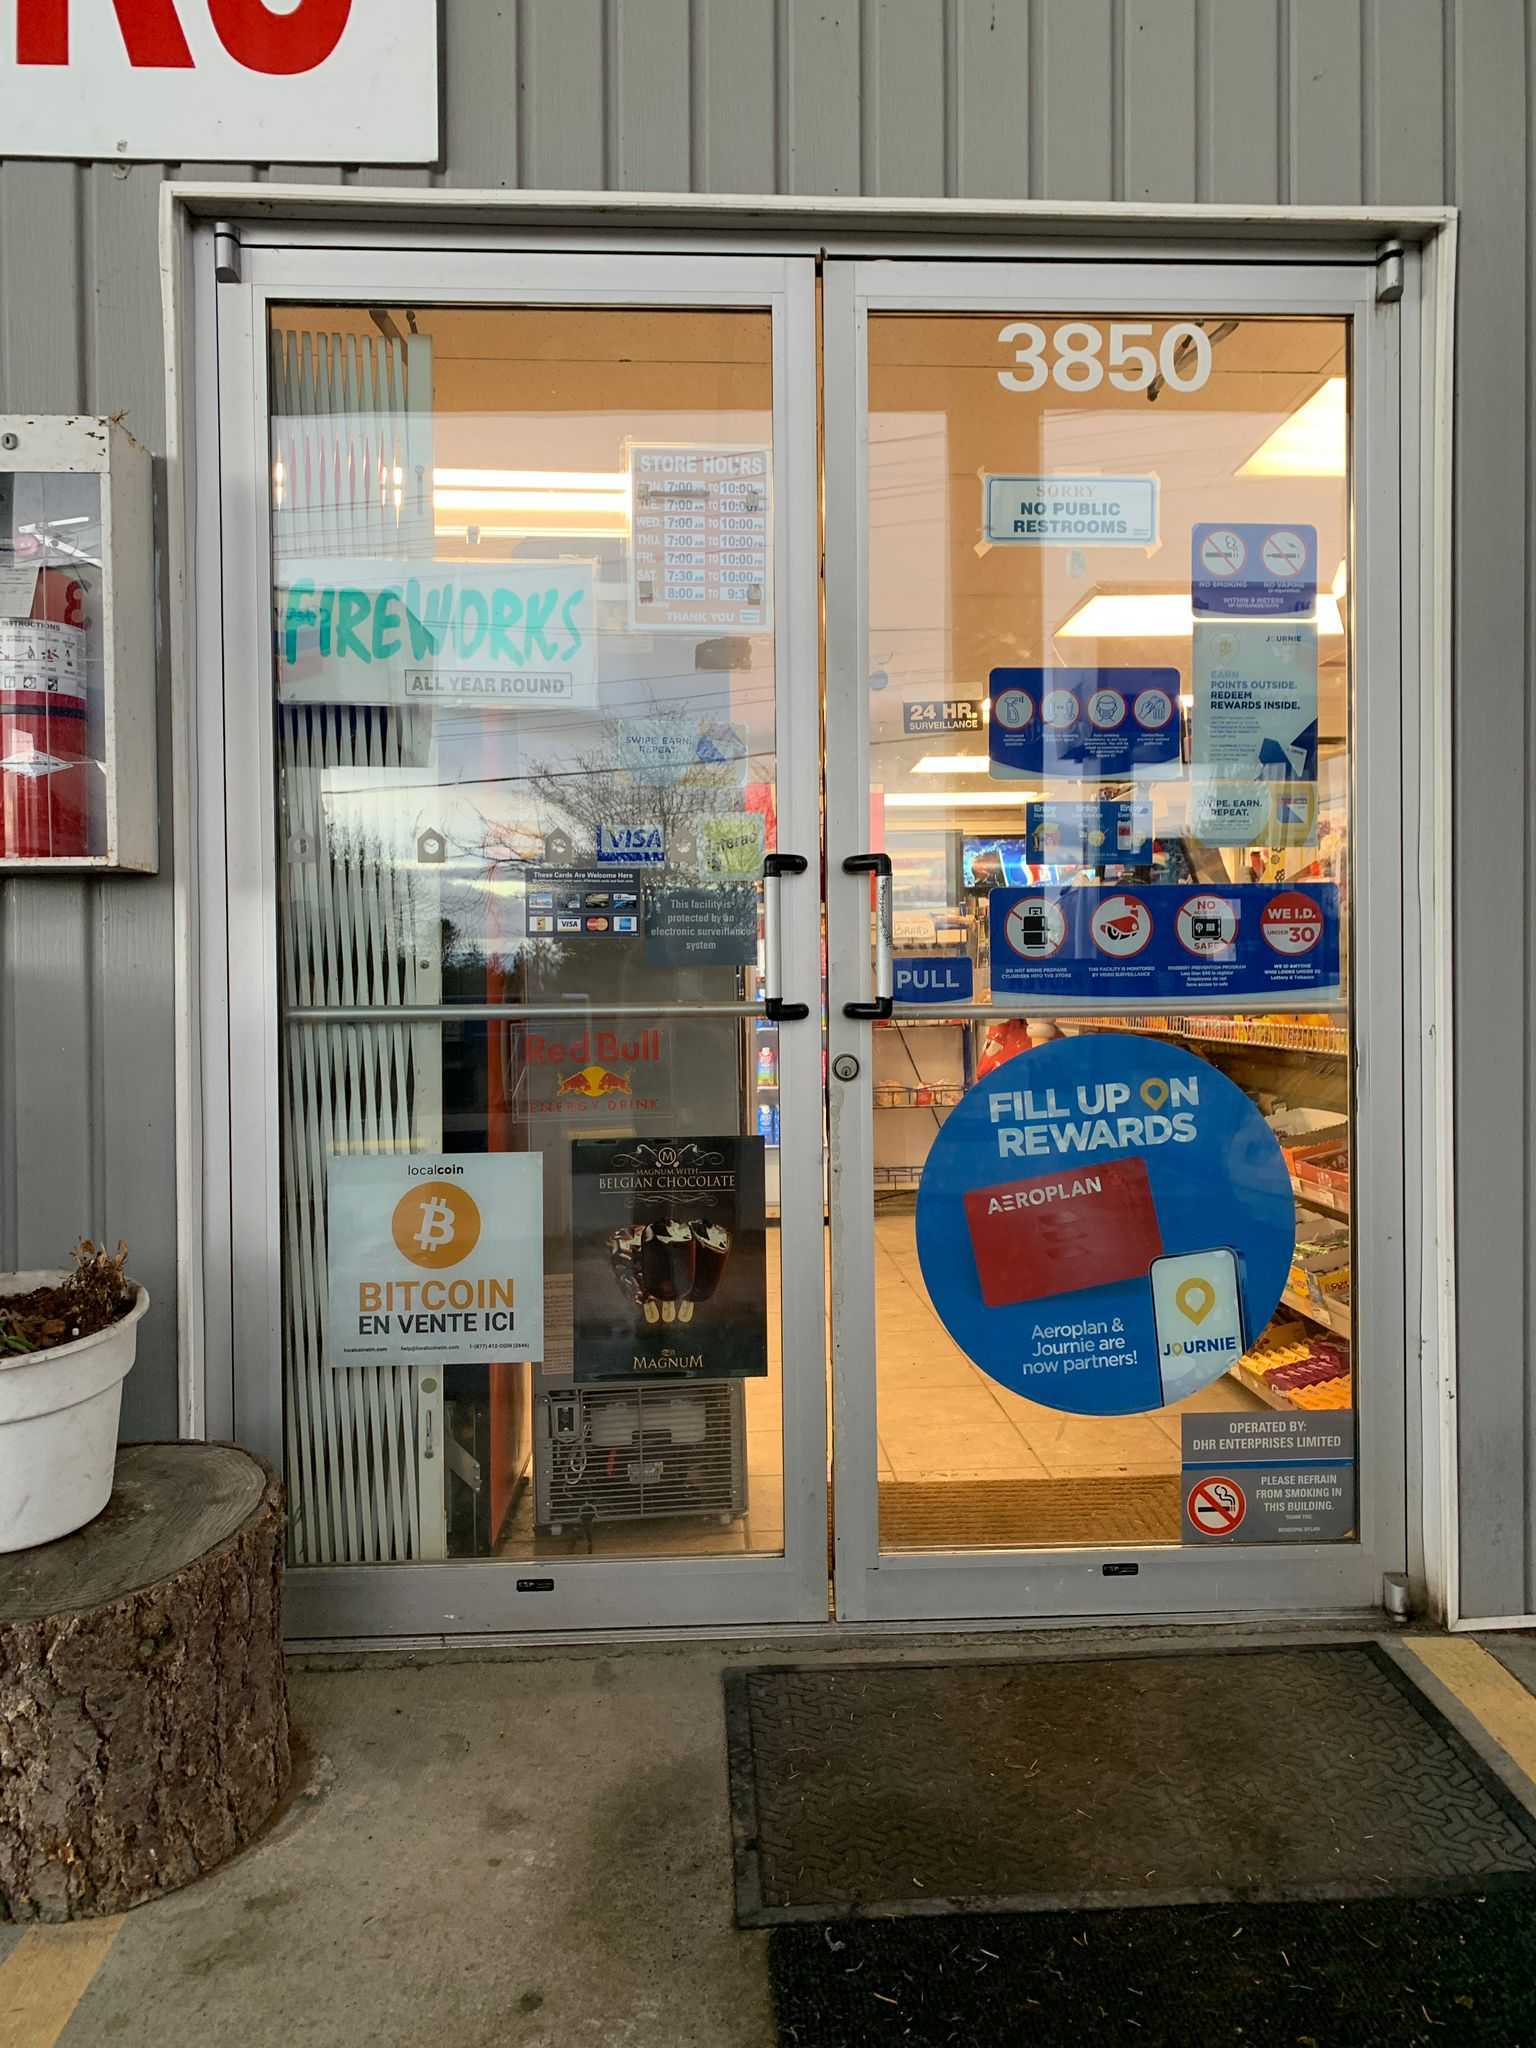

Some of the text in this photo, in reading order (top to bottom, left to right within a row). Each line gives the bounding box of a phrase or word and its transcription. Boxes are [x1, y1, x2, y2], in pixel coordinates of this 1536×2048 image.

[997, 322, 1212, 393] 3850
[640, 455, 763, 475] STORE HOURS
[721, 482, 752, 494] 10:00
[1036, 485, 1095, 498] SORRY
[667, 499, 693, 511] 7:00
[1020, 502, 1121, 516] NO PUBLIC
[667, 517, 693, 529] 7:00
[721, 518, 753, 530] 10:00
[1013, 519, 1127, 534] RESTROOMS
[667, 535, 693, 546] 7:00
[721, 536, 753, 547] 10:00
[667, 553, 693, 564] 7:00
[721, 554, 753, 565] 10:00
[667, 571, 693, 582] 7:30
[721, 571, 753, 583] 10:00
[667, 588, 693, 599] 8:00
[285, 577, 584, 667] FIREWORKS
[1210, 671, 1240, 679] EARN
[412, 675, 566, 694] ALL YEAR ROUND
[1210, 680, 1298, 690] POINTS OUTSIDE.
[1210, 691, 1252, 700] REDEEM
[910, 703, 978, 722] 24 HR.
[1210, 701, 1301, 711] REWARDS INSIDE.
[910, 719, 978, 731] SURVEILLANCE
[1233, 799, 1263, 808] EARN.
[1211, 808, 1249, 817] REPEAT.
[608, 828, 662, 849] VISA
[533, 871, 633, 879] These Cards Are Welcome Here
[671, 899, 689, 909] This
[691, 899, 721, 911] facility
[1197, 901, 1216, 910] NO
[667, 913, 709, 925] protected
[711, 913, 722, 925] by
[1267, 908, 1317, 920] WE I.D.
[561, 920, 578, 928] VISA
[651, 927, 695, 937] electronic
[697, 926, 753, 937] surveillance
[1289, 927, 1316, 943] 30
[685, 940, 717, 952] system
[896, 969, 960, 989] PULL
[526, 1029, 660, 1064] Red Bull
[530, 1099, 657, 1113] ENERGY DRINK
[988, 1088, 1071, 1123] FILL
[1076, 1082, 1131, 1116] UP
[997, 1112, 1197, 1158] REWARDS
[407, 1164, 464, 1176] localcoin
[675, 1167, 699, 1175] WITH
[600, 1174, 736, 1190] BELGIAN CHOCOLATE
[987, 1175, 1102, 1216] AEROPLAN
[359, 1278, 515, 1313] BITCOIN
[358, 1311, 515, 1336] EN VENTE ICI
[1031, 1317, 1125, 1340] Aeroplan &
[1032, 1336, 1126, 1358] Journie are
[1164, 1336, 1237, 1357] JOURNIE
[632, 1354, 703, 1370] MAGNUM
[1023, 1350, 1139, 1376] now partners!
[1229, 1421, 1307, 1434] OPERATED BY:
[1193, 1435, 1341, 1451] DHR ENTERPRISES LIMITED
[1261, 1474, 1337, 1486] PLEASE REFRAIN
[1256, 1487, 1342, 1499] FROM SMOKING IN
[1264, 1500, 1335, 1512] THIS BUILDING.
